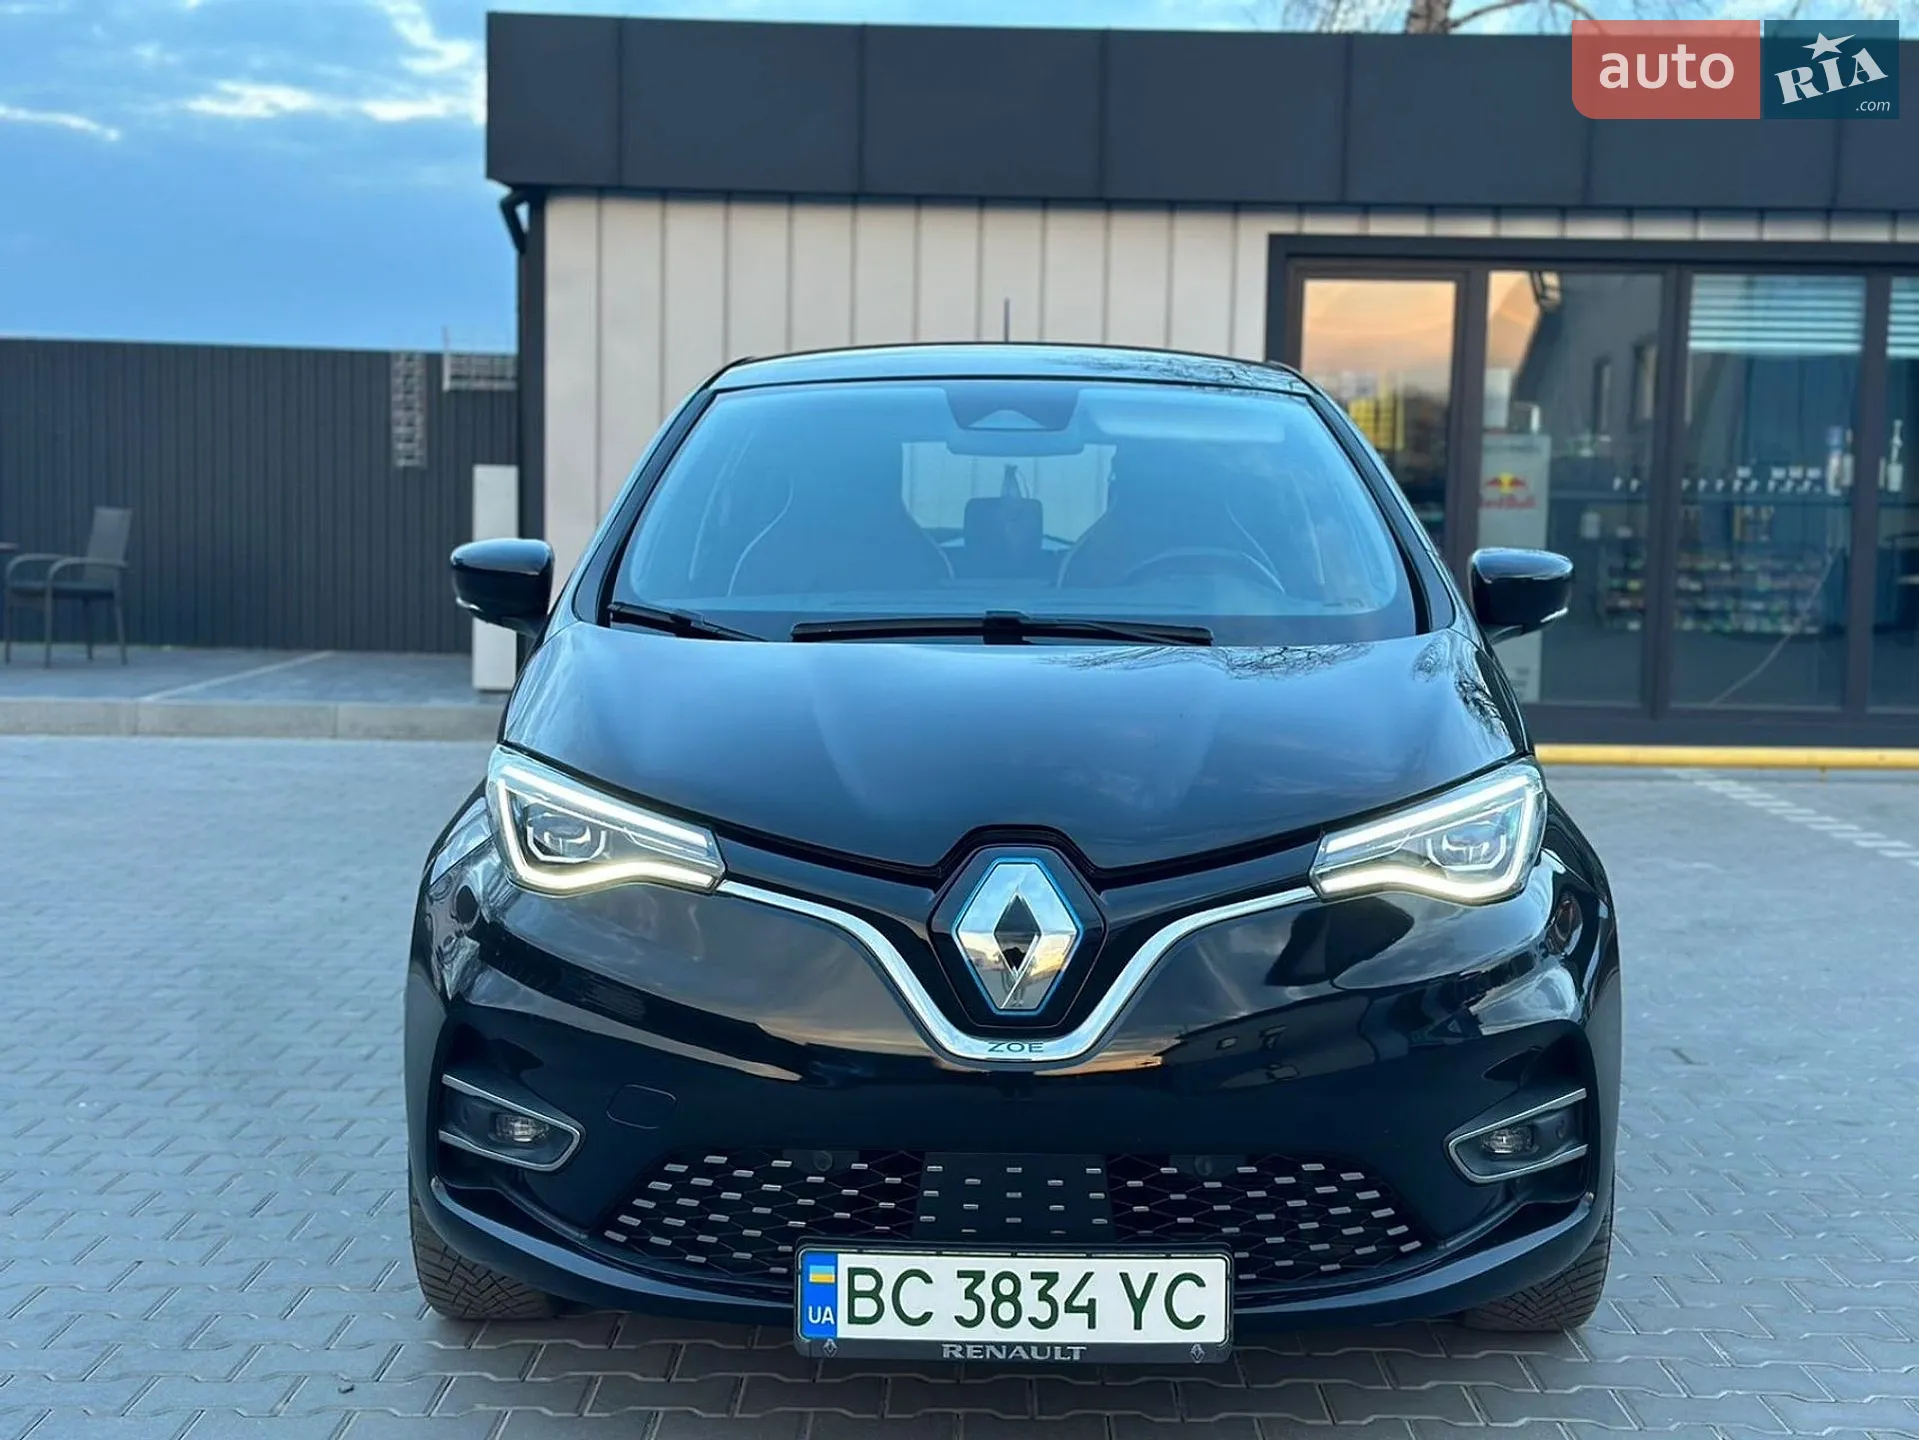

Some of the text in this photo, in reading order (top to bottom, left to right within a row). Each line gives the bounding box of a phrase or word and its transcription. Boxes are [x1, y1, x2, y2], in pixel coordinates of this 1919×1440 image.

[988, 1042, 1043, 1053] ZOE
[846, 1267, 1206, 1331] BC 3834 YC
[808, 1305, 835, 1324] UA
[941, 1343, 1087, 1361] RENAULT
